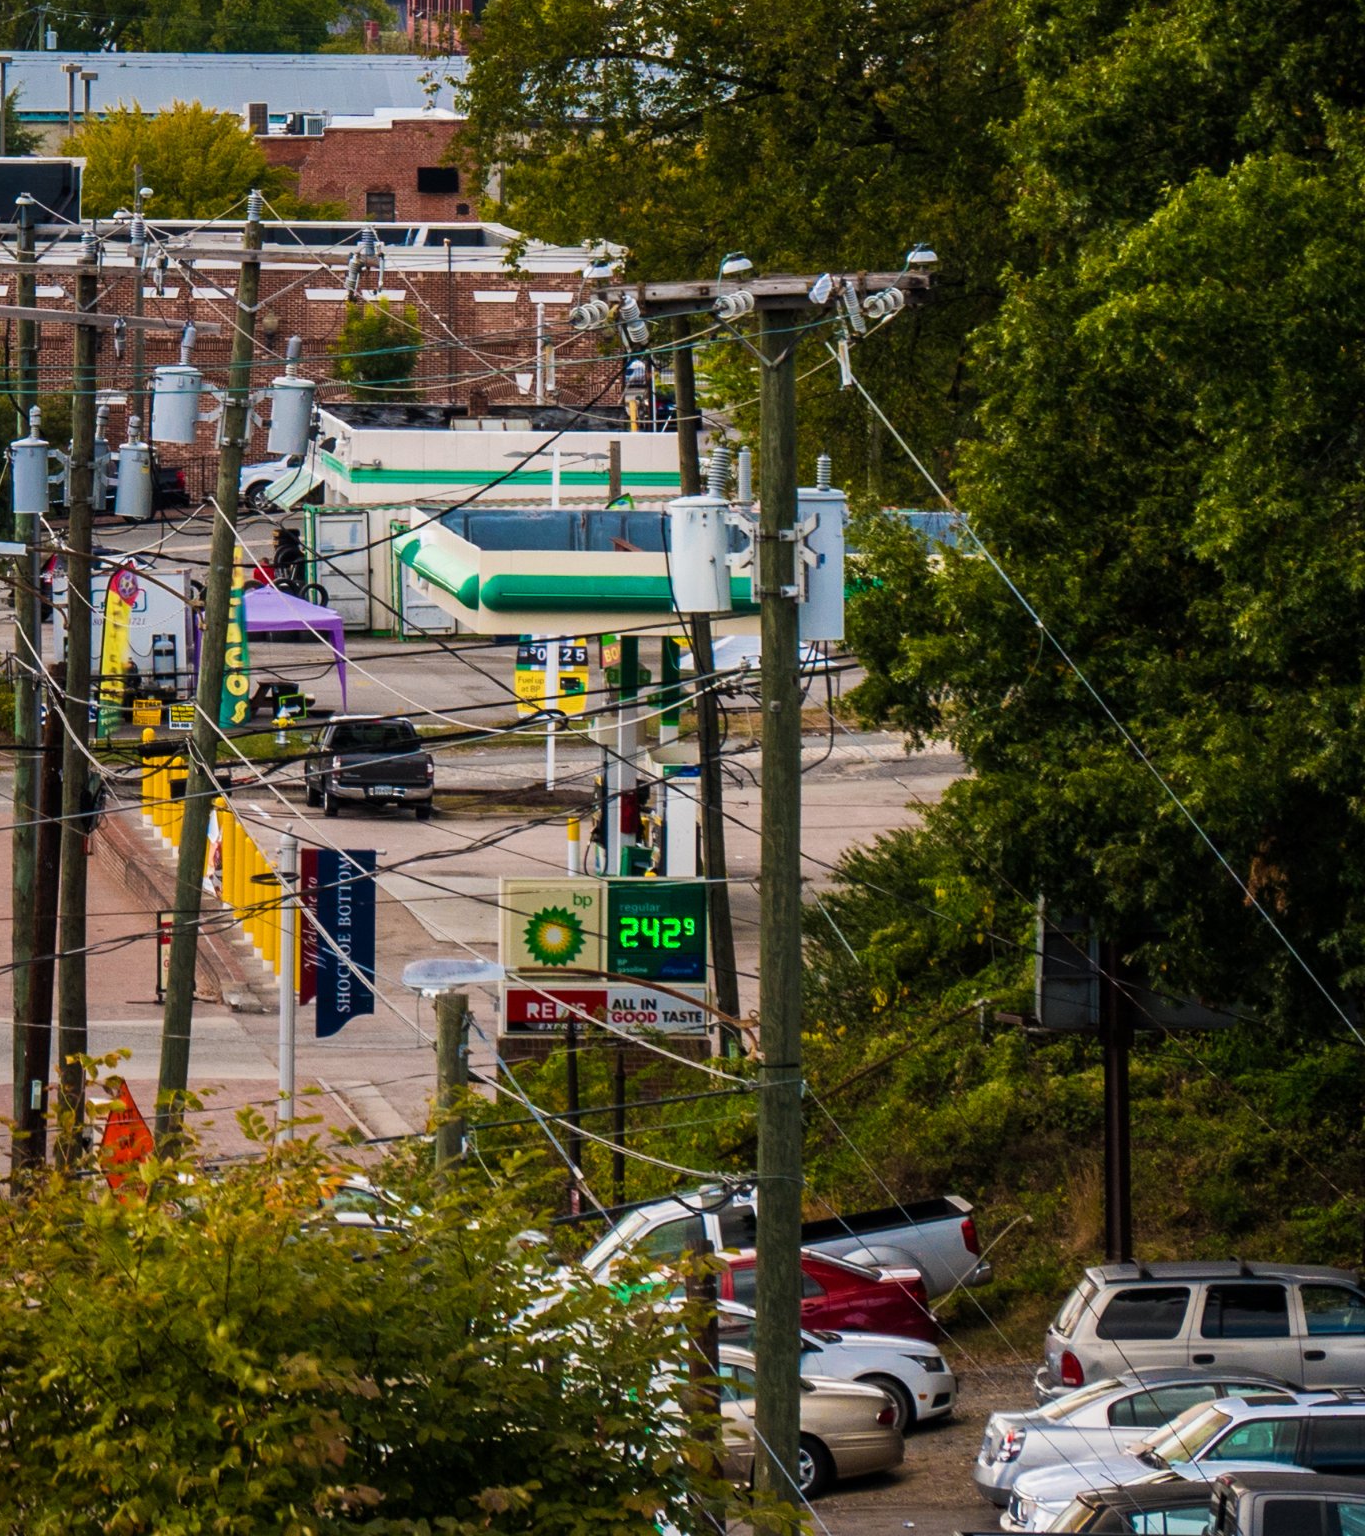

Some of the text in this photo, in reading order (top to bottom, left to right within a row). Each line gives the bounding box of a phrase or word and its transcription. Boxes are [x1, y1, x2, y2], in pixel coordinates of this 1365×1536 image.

[517, 675, 534, 684] Fuel
[337, 855, 353, 927] BOTTOM
[573, 892, 593, 909] bp
[619, 903, 661, 914] regular
[302, 895, 327, 973] Welcme
[612, 998, 657, 1011] ALL IN
[611, 1011, 702, 1024] GOOD TASTE
